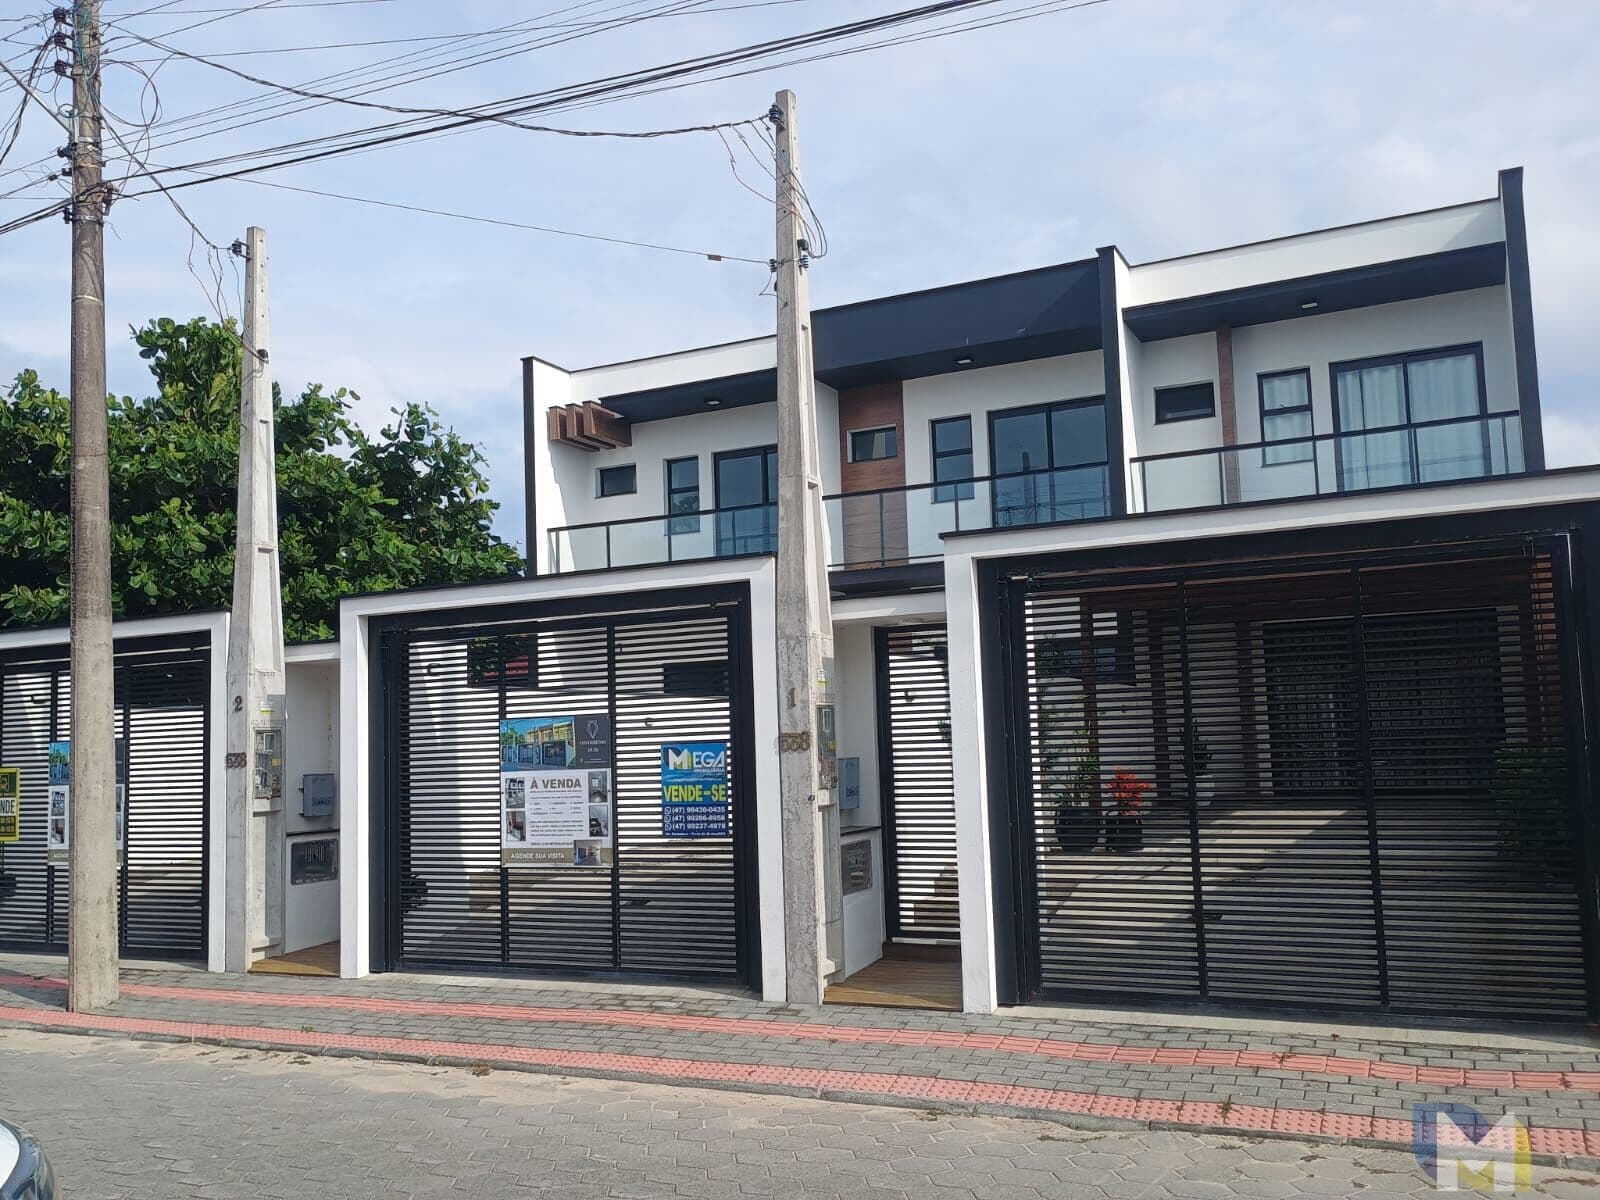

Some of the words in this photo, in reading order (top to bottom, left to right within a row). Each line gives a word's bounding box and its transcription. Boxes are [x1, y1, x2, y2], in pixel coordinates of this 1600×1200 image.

[233, 695, 243, 712] 2
[668, 748, 726, 770] MEGA
[541, 778, 583, 789] VENDA
[672, 806, 685, 814] (47)
